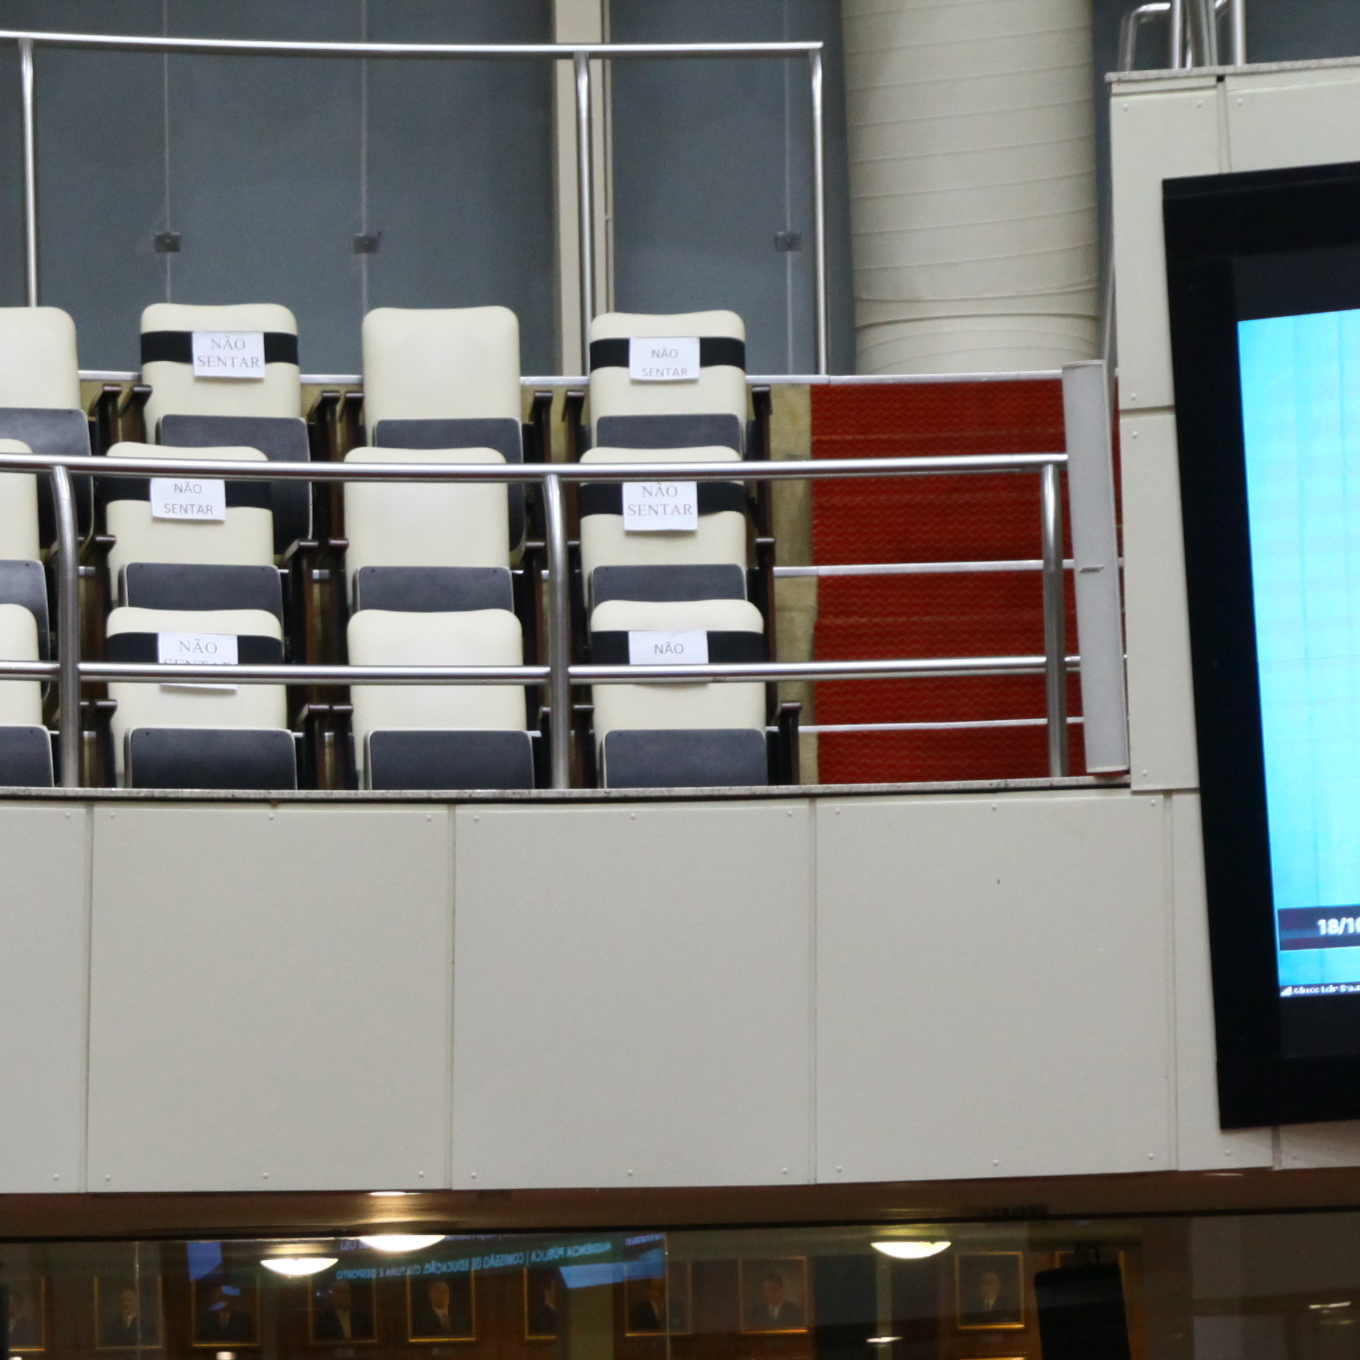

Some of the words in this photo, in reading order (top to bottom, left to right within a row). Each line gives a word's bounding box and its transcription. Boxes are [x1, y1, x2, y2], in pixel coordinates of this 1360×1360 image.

[211, 335, 246, 351] NÃO
[651, 347, 679, 359] NÃO
[197, 355, 260, 369] SENTAR
[642, 367, 688, 378] SENTAR
[173, 481, 202, 495] NÃO
[642, 482, 678, 498] NÃO
[164, 503, 214, 515] SENTAR
[628, 504, 693, 516] SENTAR
[179, 638, 218, 655] NÃO
[654, 641, 684, 655] NÃO
